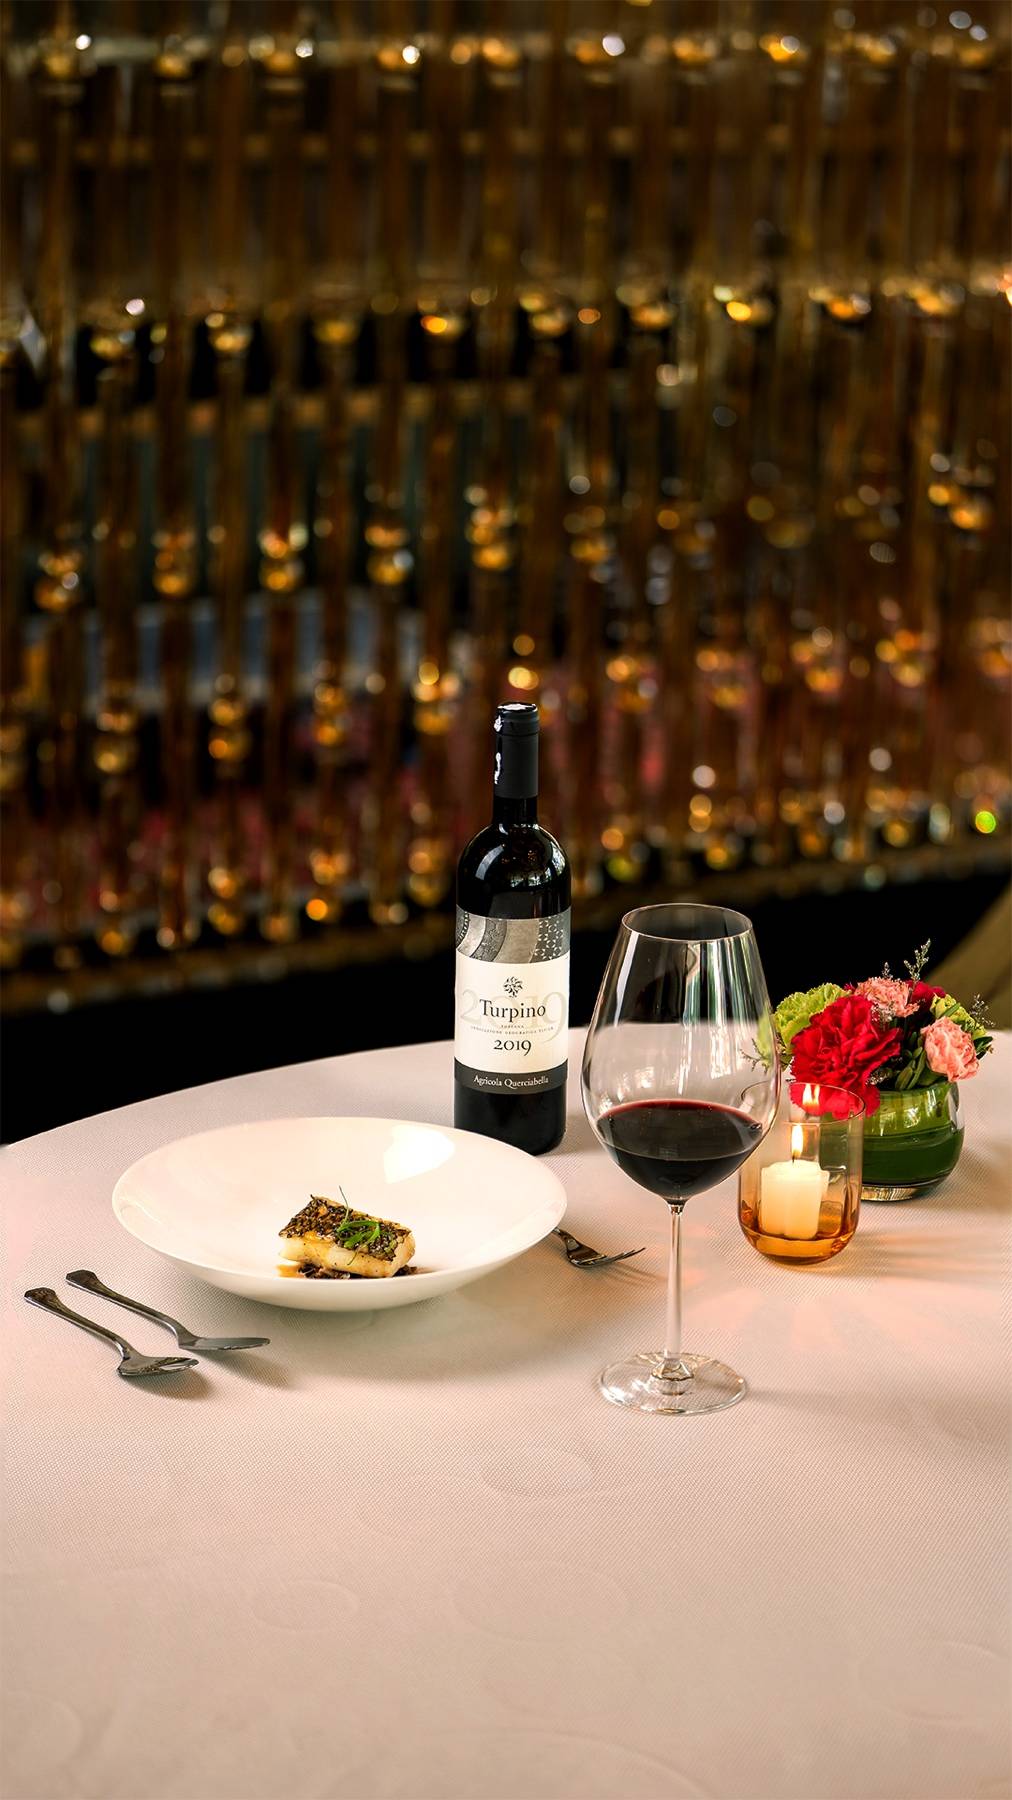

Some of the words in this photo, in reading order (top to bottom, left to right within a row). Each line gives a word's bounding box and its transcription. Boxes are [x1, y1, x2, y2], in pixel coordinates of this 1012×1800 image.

[479, 998, 547, 1023] Turpino
[493, 1039, 532, 1057] 2019
[473, 1075, 502, 1087] Agricola
[504, 1075, 549, 1090] Querciabella
